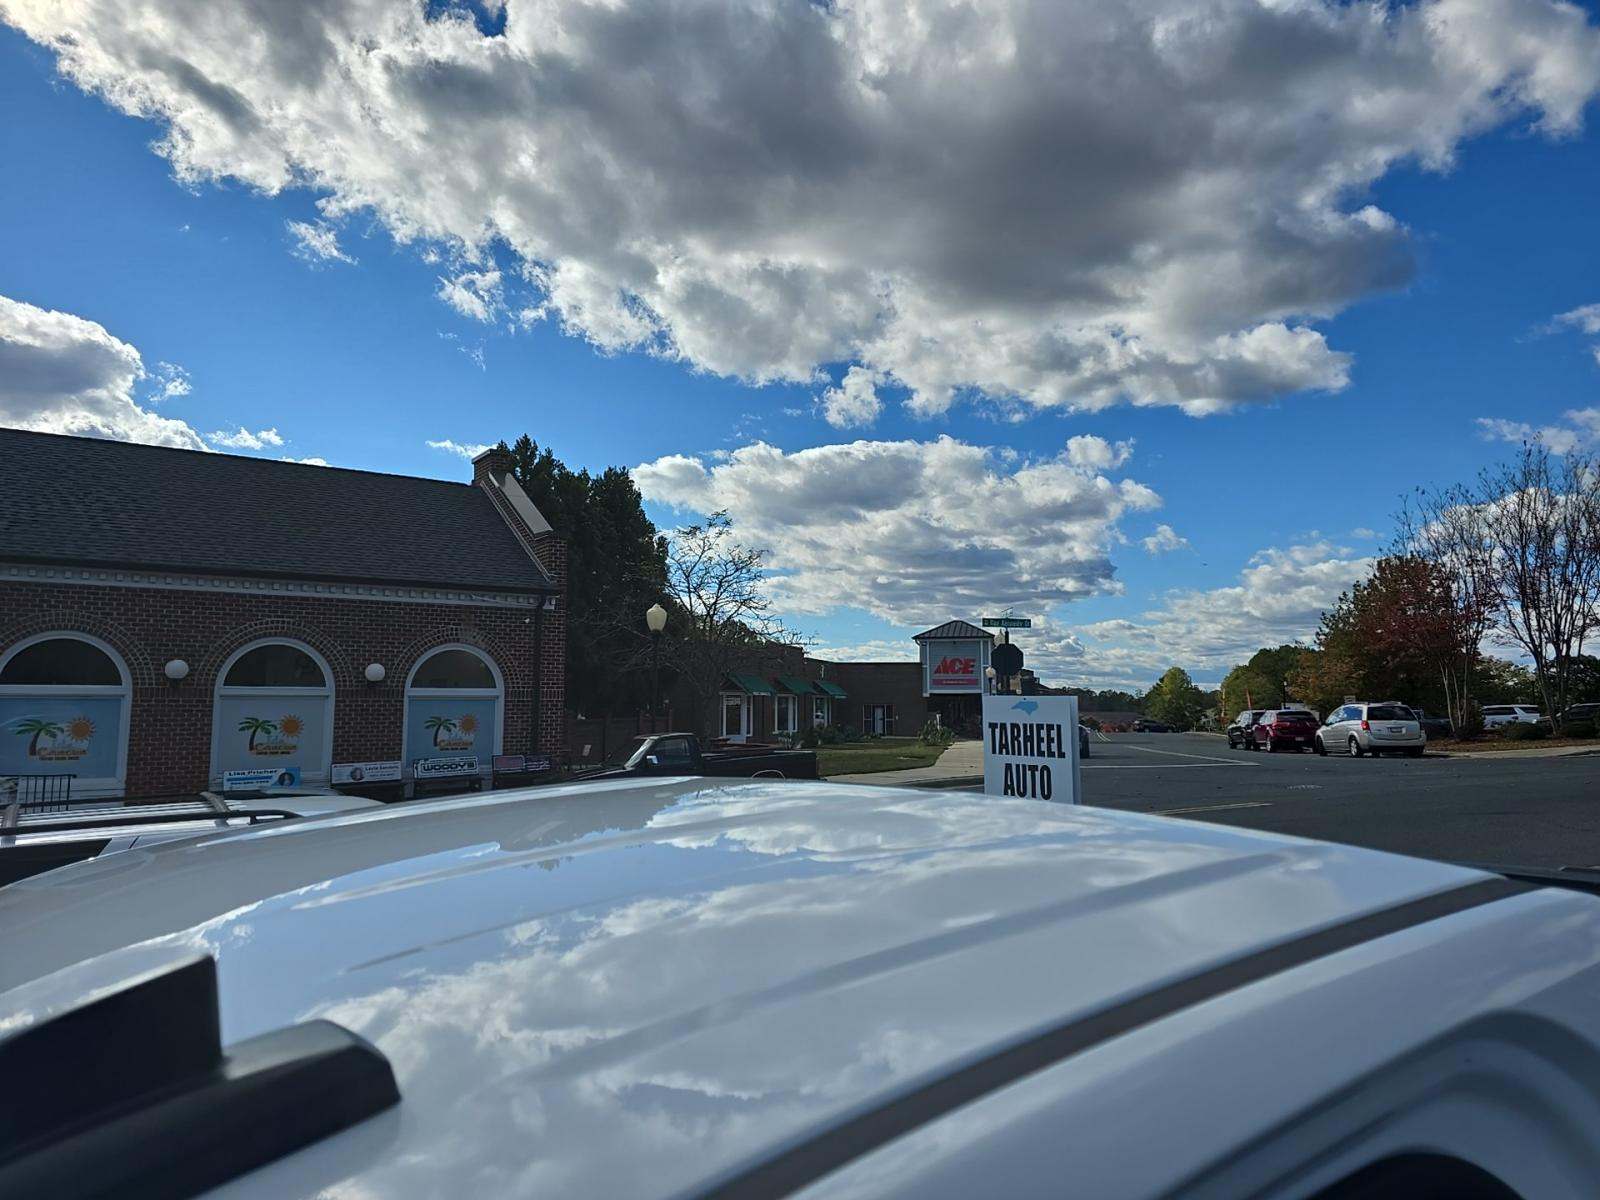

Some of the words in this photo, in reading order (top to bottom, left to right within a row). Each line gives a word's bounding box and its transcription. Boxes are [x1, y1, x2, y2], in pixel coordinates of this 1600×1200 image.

[934, 656, 976, 674] ACE
[988, 722, 1066, 758] TARHEEL
[1003, 763, 1053, 800] AUTO
